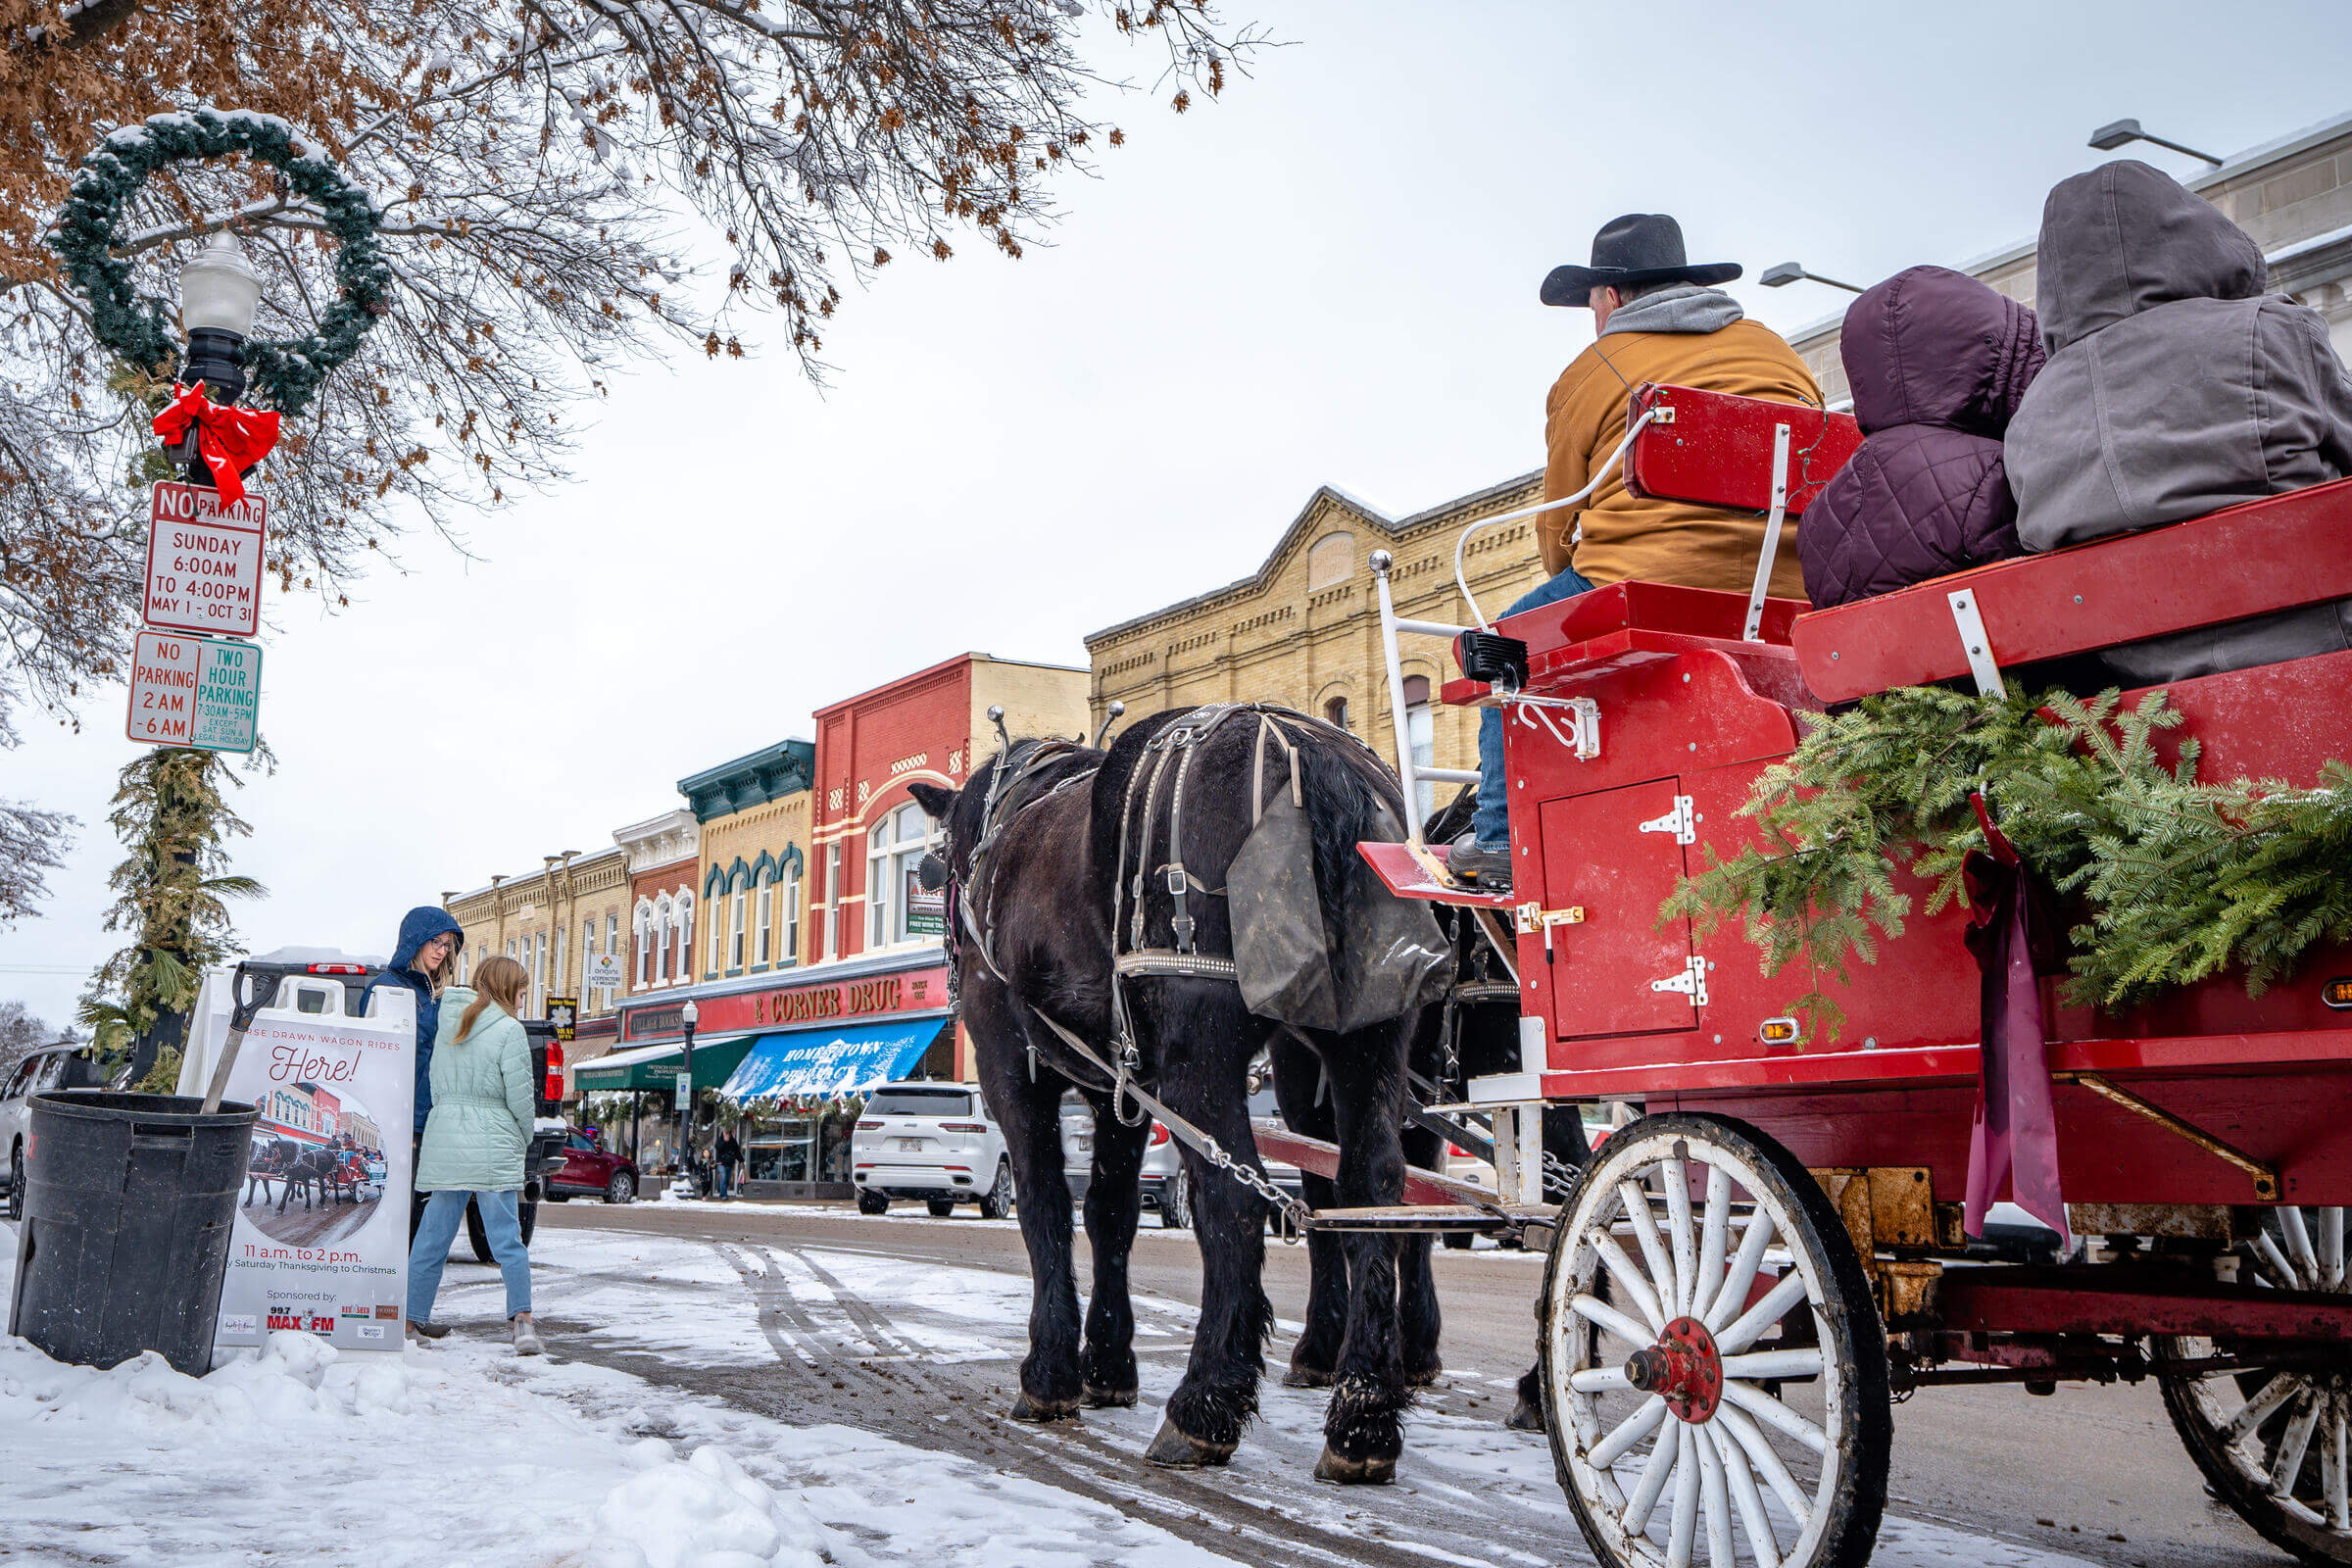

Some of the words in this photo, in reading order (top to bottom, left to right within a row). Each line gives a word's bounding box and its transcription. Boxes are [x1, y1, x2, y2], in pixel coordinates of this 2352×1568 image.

[160, 488, 194, 518] NO
[172, 532, 241, 556] SUNDAY
[173, 556, 236, 578] 6:00AM
[157, 575, 176, 593] TO
[185, 580, 250, 603] 4:00PM
[151, 596, 179, 612] MAY
[185, 601, 190, 614] 1
[208, 603, 233, 618] OCT
[238, 607, 252, 621] 31
[157, 641, 180, 661] NO
[217, 649, 243, 667] TWO
[136, 665, 194, 688] PARKING
[209, 667, 246, 687] HOUR
[143, 692, 154, 709] 2
[158, 694, 183, 712] AM
[198, 684, 253, 707] PARKING
[160, 718, 185, 737] AM
[209, 718, 238, 728] EXCEPT
[220, 727, 235, 736] SUN
[195, 732, 218, 742] LEGAL
[220, 735, 250, 745] HOLIDAY
[770, 988, 841, 1021] CORNER
[847, 978, 902, 1013] DRUG
[659, 1011, 684, 1028] BOOKS
[272, 1030, 315, 1042] DRAWN
[320, 1036, 363, 1047] WAGON
[368, 1040, 400, 1051] RIDES
[269, 1045, 362, 1086] Here!
[245, 1245, 256, 1257] 11
[260, 1248, 292, 1259] a.m.
[297, 1248, 313, 1260] to
[317, 1249, 325, 1261] 2
[329, 1251, 363, 1264] p.m.
[235, 1259, 276, 1270] Saturday
[278, 1261, 339, 1273] Thanksgiving
[352, 1265, 397, 1275] Christmas
[267, 1290, 320, 1300] Sponsored
[322, 1291, 337, 1302] by:
[270, 1306, 291, 1315] 99.7
[267, 1315, 302, 1331] MAX
[312, 1315, 334, 1332] FM
